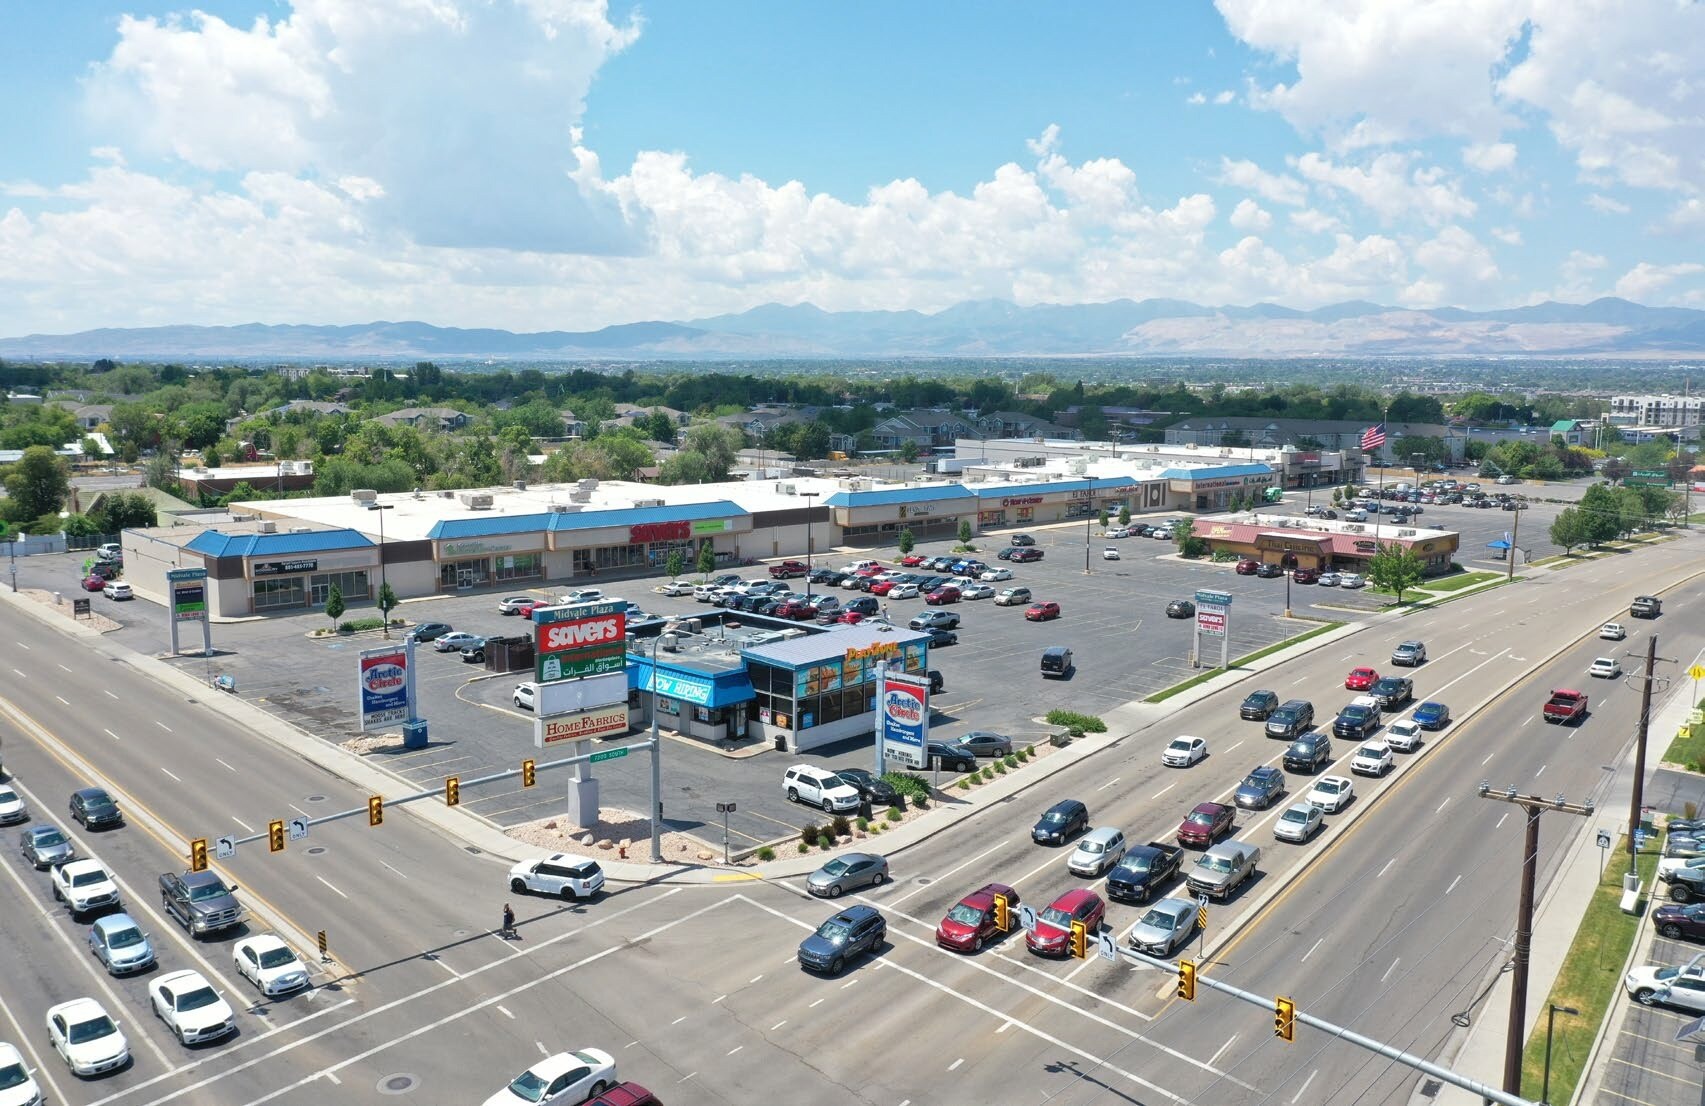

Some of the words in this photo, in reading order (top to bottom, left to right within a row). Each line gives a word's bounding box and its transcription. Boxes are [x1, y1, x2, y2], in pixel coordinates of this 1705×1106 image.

[554, 608, 588, 620] Midvale
[591, 605, 614, 615] Plaza
[548, 619, 618, 648] savers
[366, 667, 402, 683] Arctic
[368, 677, 402, 691] Circle
[887, 693, 920, 712] Arctic
[889, 704, 920, 722] Circle
[1101, 949, 1114, 959] ONLY
